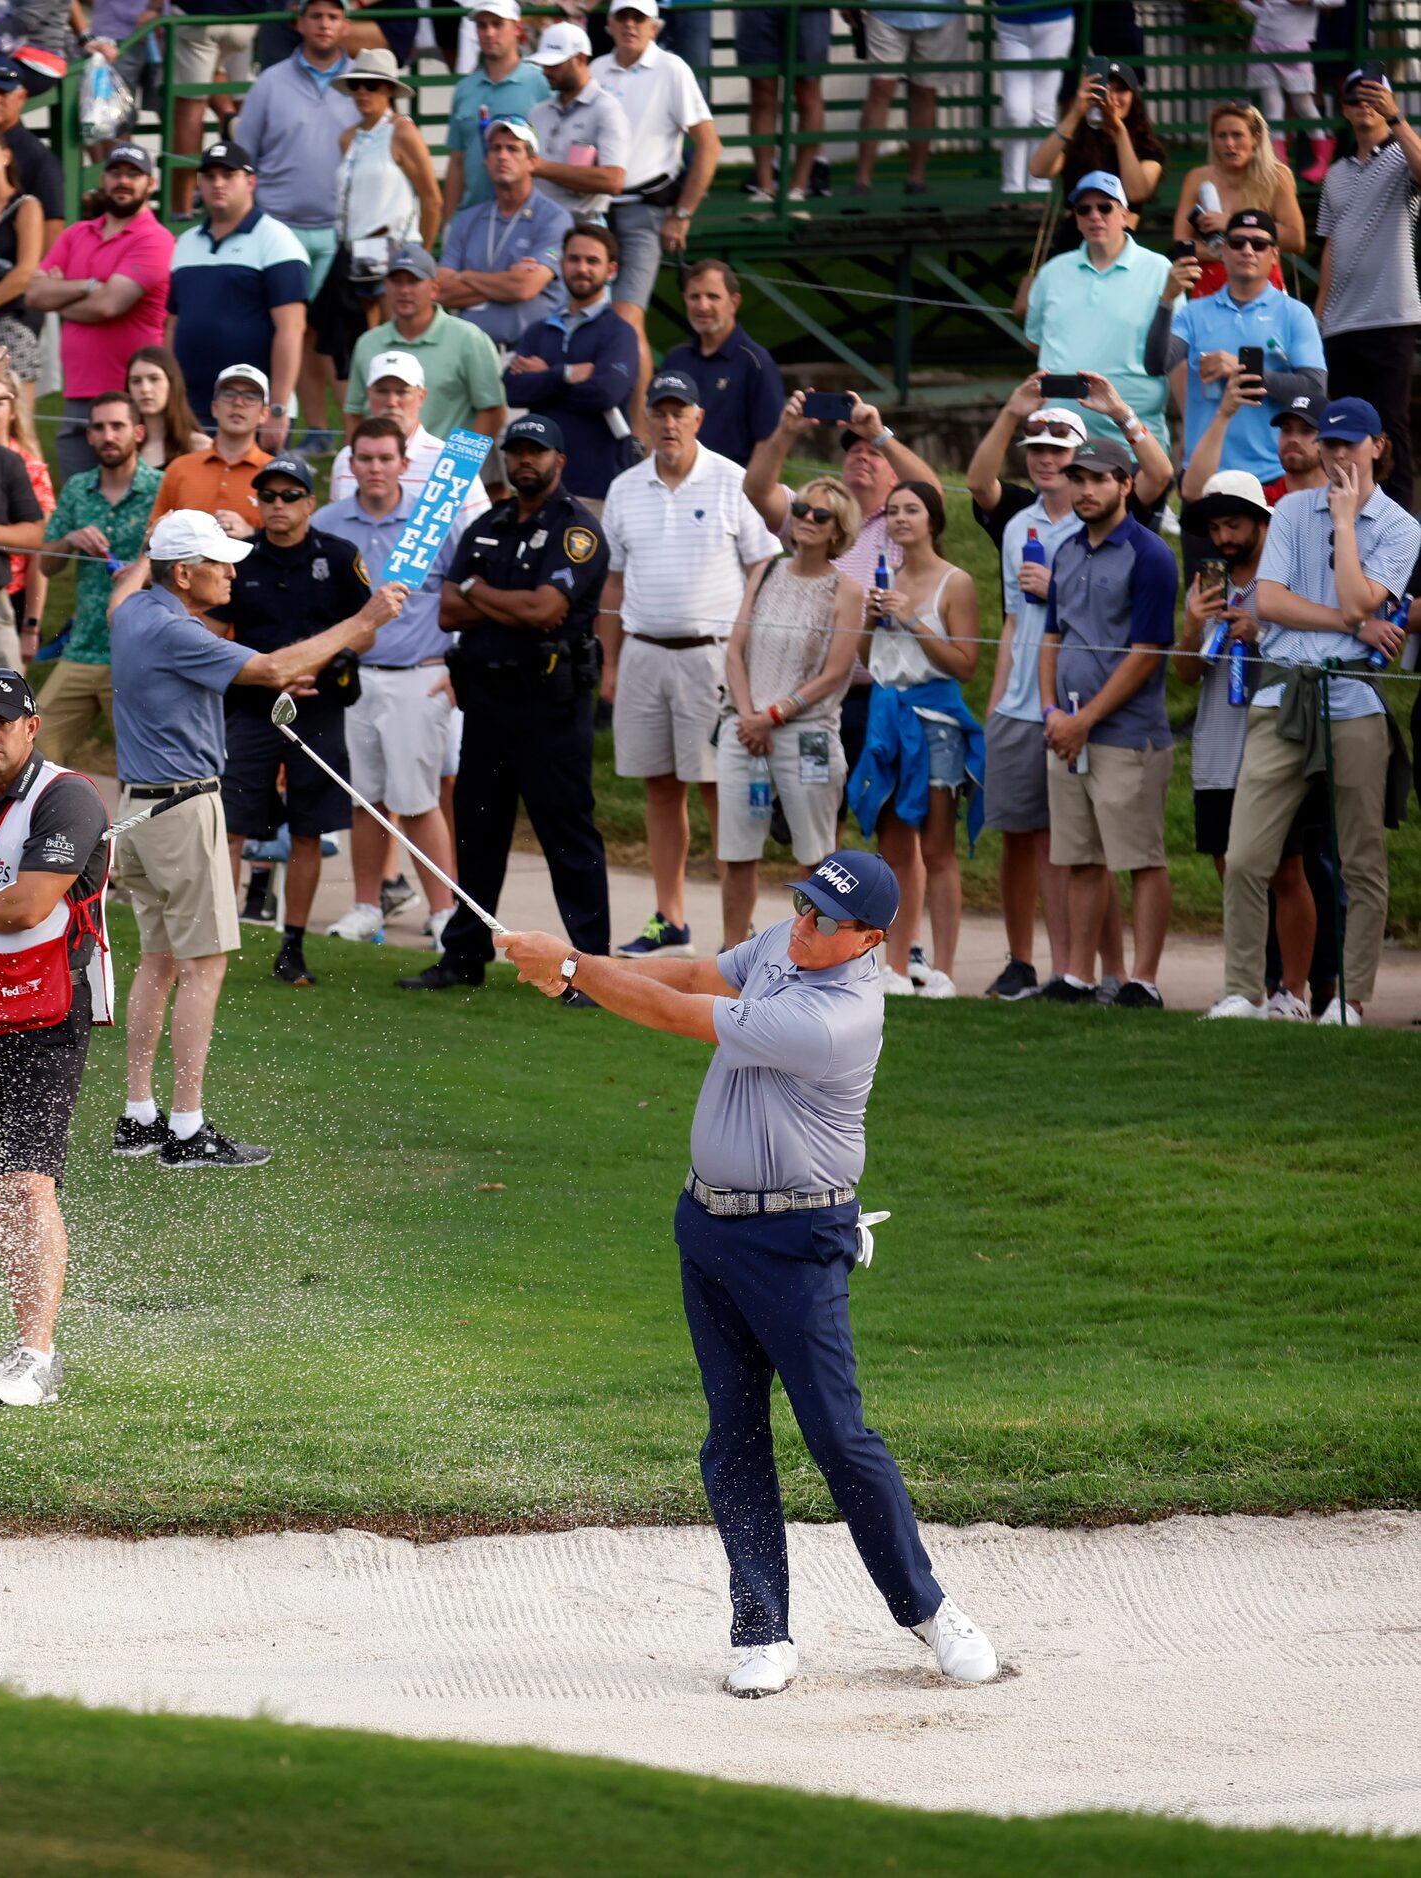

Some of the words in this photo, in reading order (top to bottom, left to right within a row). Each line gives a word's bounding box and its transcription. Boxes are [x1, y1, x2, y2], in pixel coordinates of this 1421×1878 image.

[449, 431, 490, 451] charles
[389, 457, 456, 574] QUIET
[409, 475, 470, 570] Y'ALL
[45, 837, 75, 852] BRIDGES
[54, 832, 67, 842] THE
[815, 865, 852, 894] KPMG
[1, 984, 31, 997] FedEx
